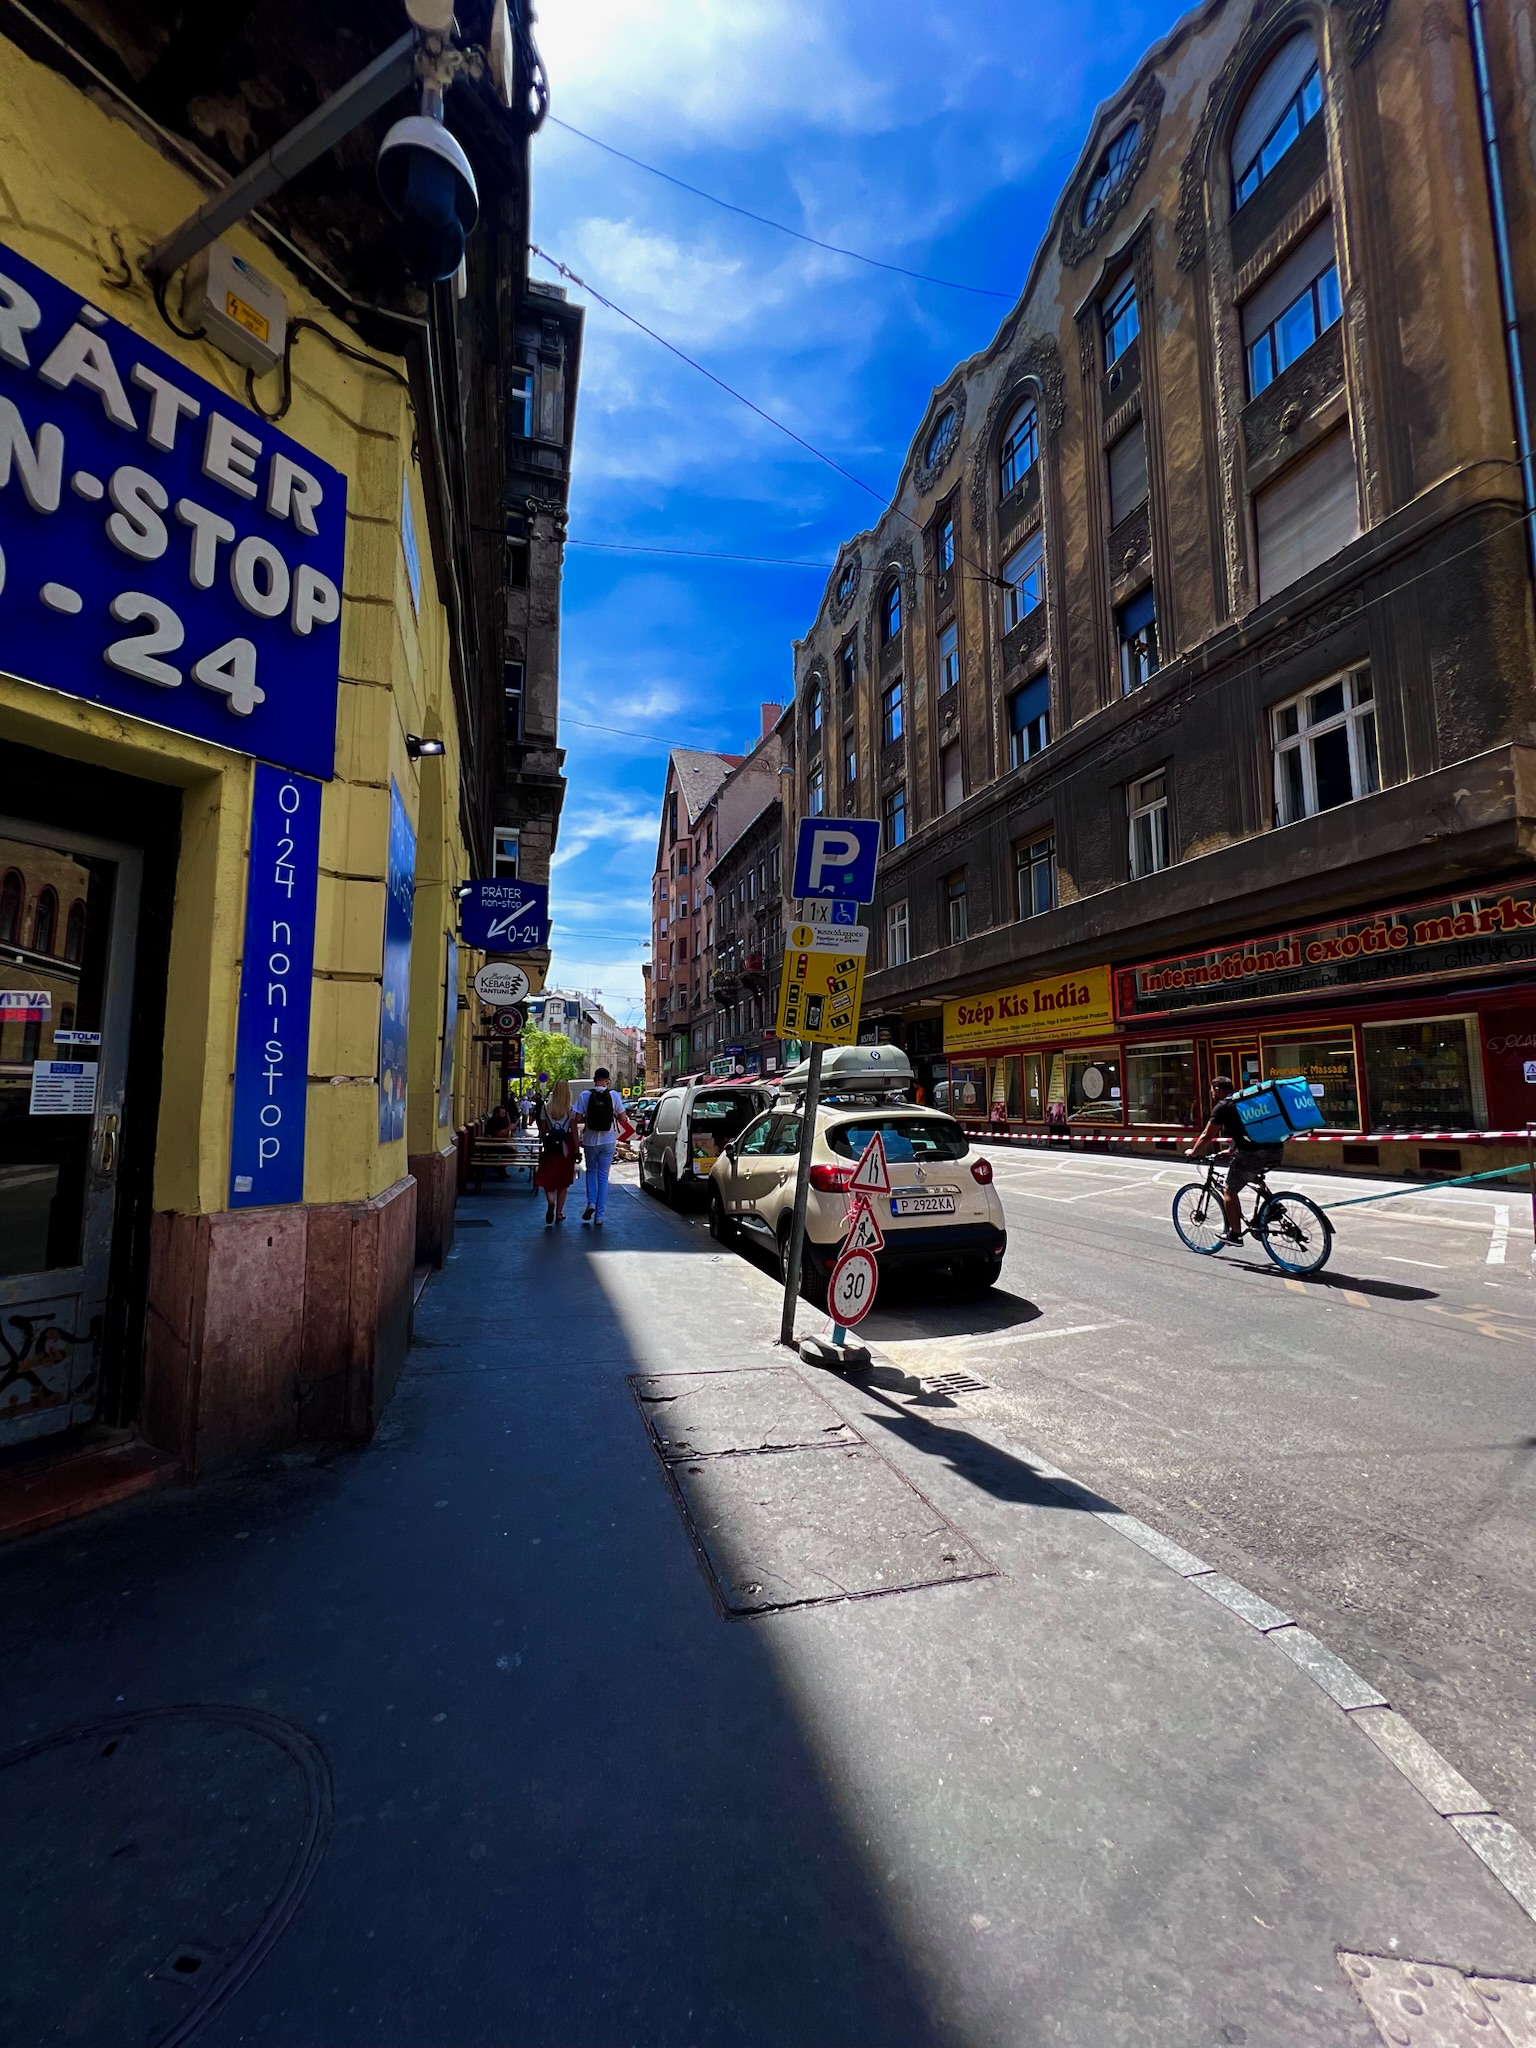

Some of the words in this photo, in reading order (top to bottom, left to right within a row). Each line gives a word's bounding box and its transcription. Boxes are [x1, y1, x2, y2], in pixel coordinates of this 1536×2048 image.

[808, 829, 860, 889] P
[481, 885, 522, 899] PRÁTER
[481, 898, 522, 910] non-stop
[507, 924, 540, 943] 0-24
[1140, 937, 1303, 992] International
[1305, 921, 1409, 962] exotic
[1414, 895, 1536, 945] mark
[480, 977, 511, 988] KEBAB
[479, 987, 510, 995] TANTUNI
[957, 1001, 995, 1027] Szép
[998, 994, 1029, 1019] Kis
[1033, 982, 1091, 1013] India
[71, 1032, 100, 1041] TOLNI
[1269, 1065, 1308, 1076] Ayurvedic
[1310, 1064, 1349, 1075] Massage
[1242, 1103, 1270, 1121] Wolt
[901, 1200, 909, 1212] P
[843, 1272, 865, 1301] 30
